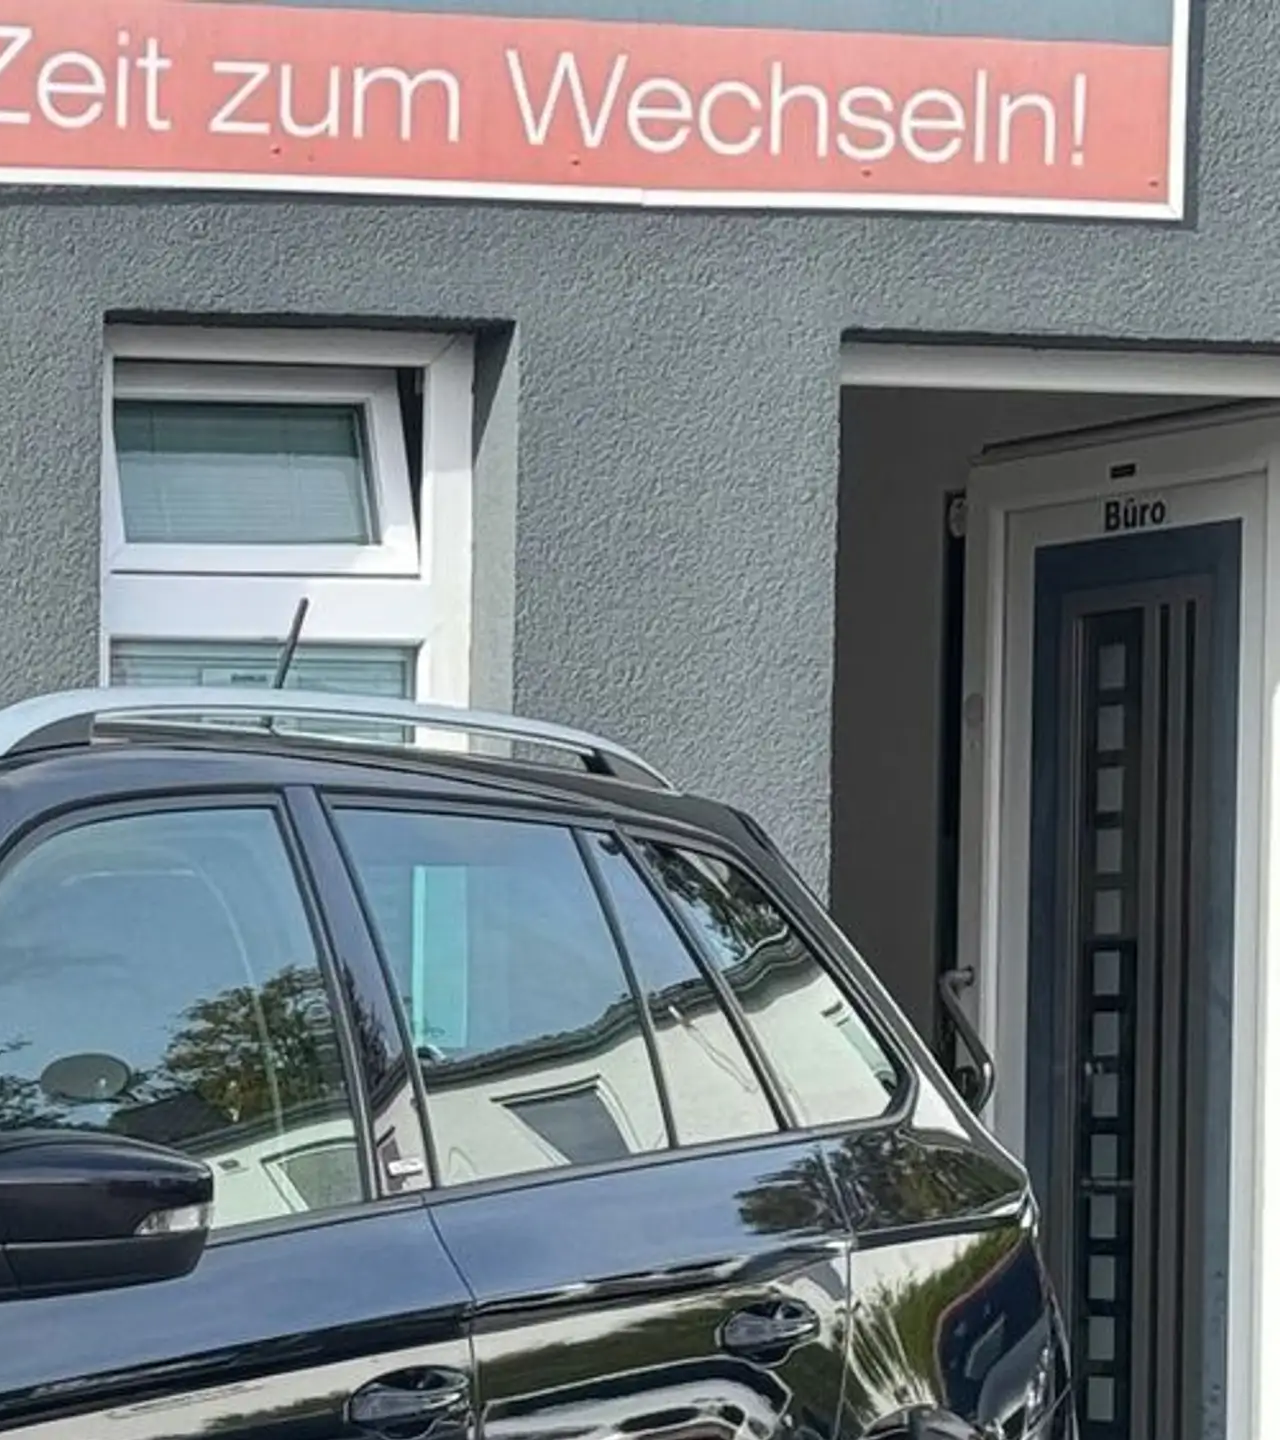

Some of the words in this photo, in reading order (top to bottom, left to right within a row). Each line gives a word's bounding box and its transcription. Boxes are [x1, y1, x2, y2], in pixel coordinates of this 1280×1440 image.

[209, 60, 459, 142] zum
[506, 48, 1088, 167] Wechseln!
[1104, 497, 1166, 532] Büro
